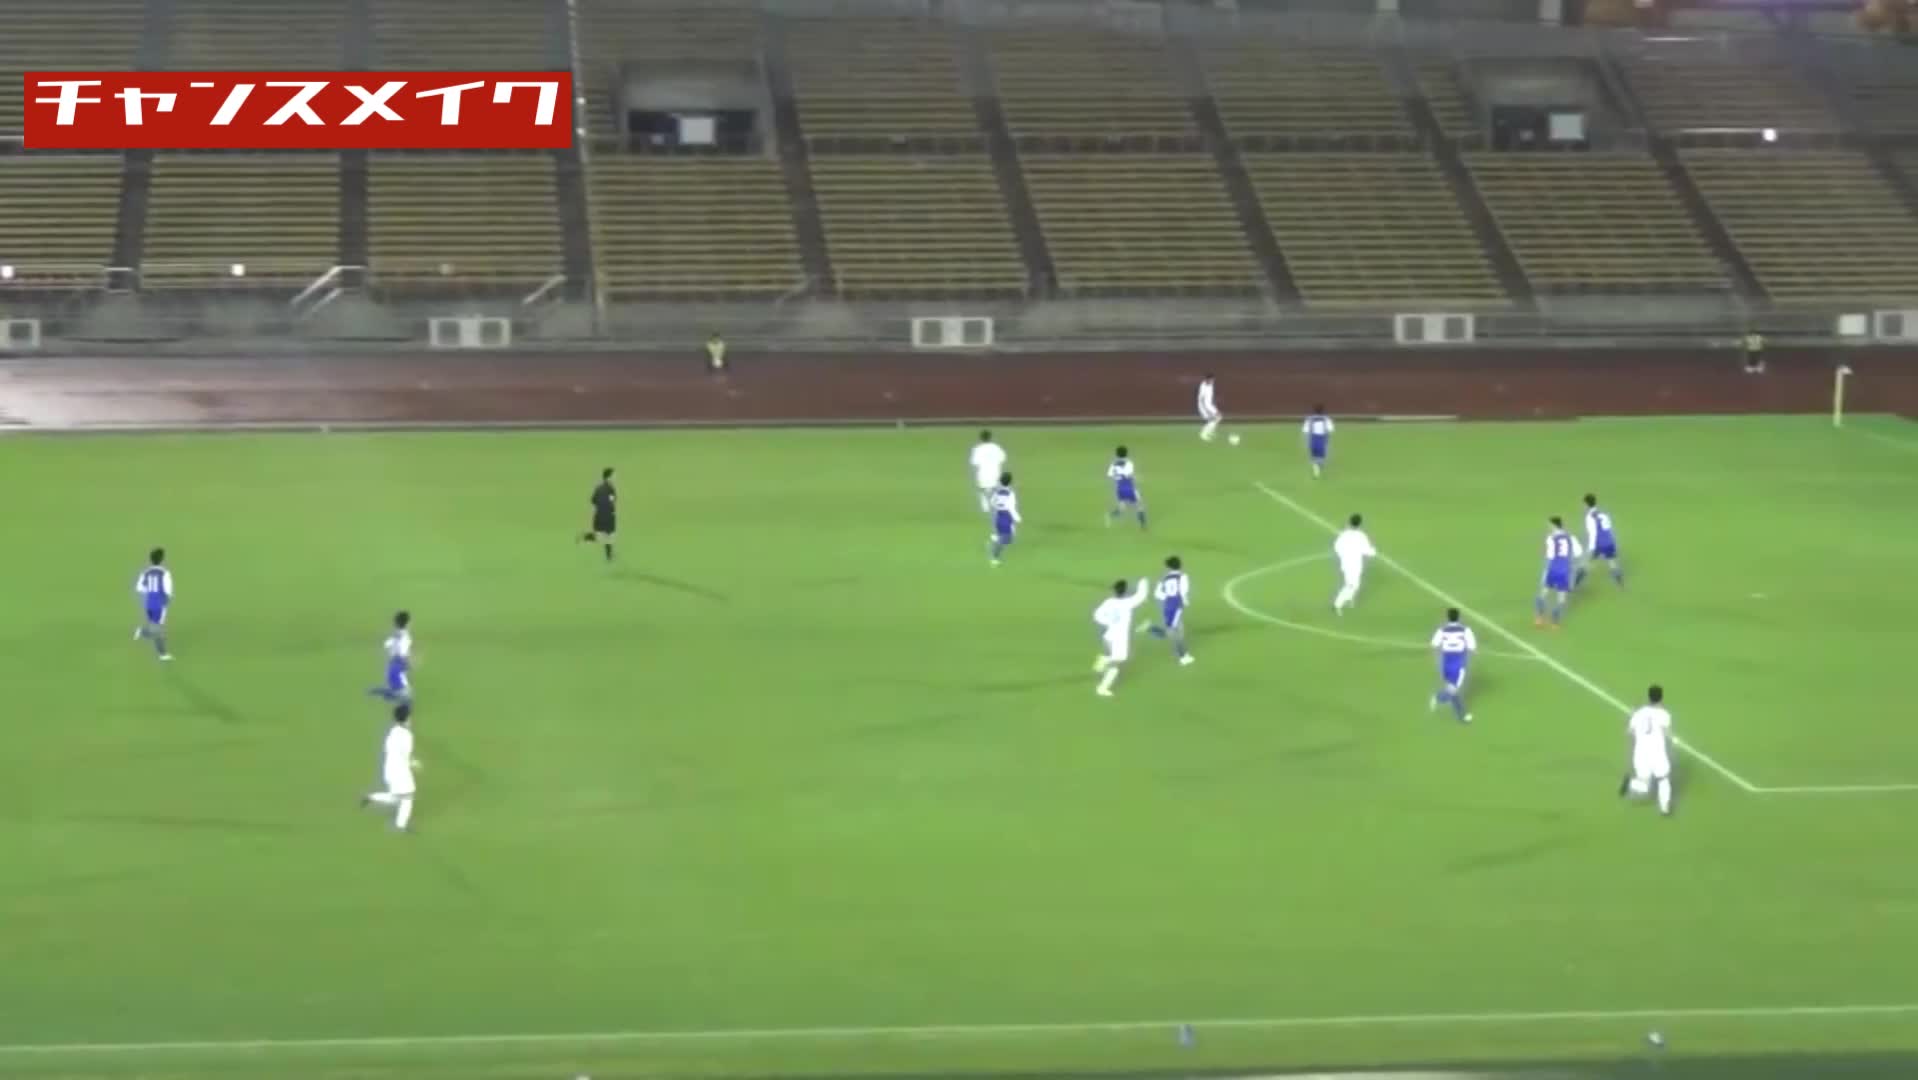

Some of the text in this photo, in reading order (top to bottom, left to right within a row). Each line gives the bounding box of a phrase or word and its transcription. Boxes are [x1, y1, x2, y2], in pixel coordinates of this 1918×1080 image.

[1557, 537, 1568, 557] 3
[147, 574, 159, 593] 11
[1441, 630, 1465, 652] 25
